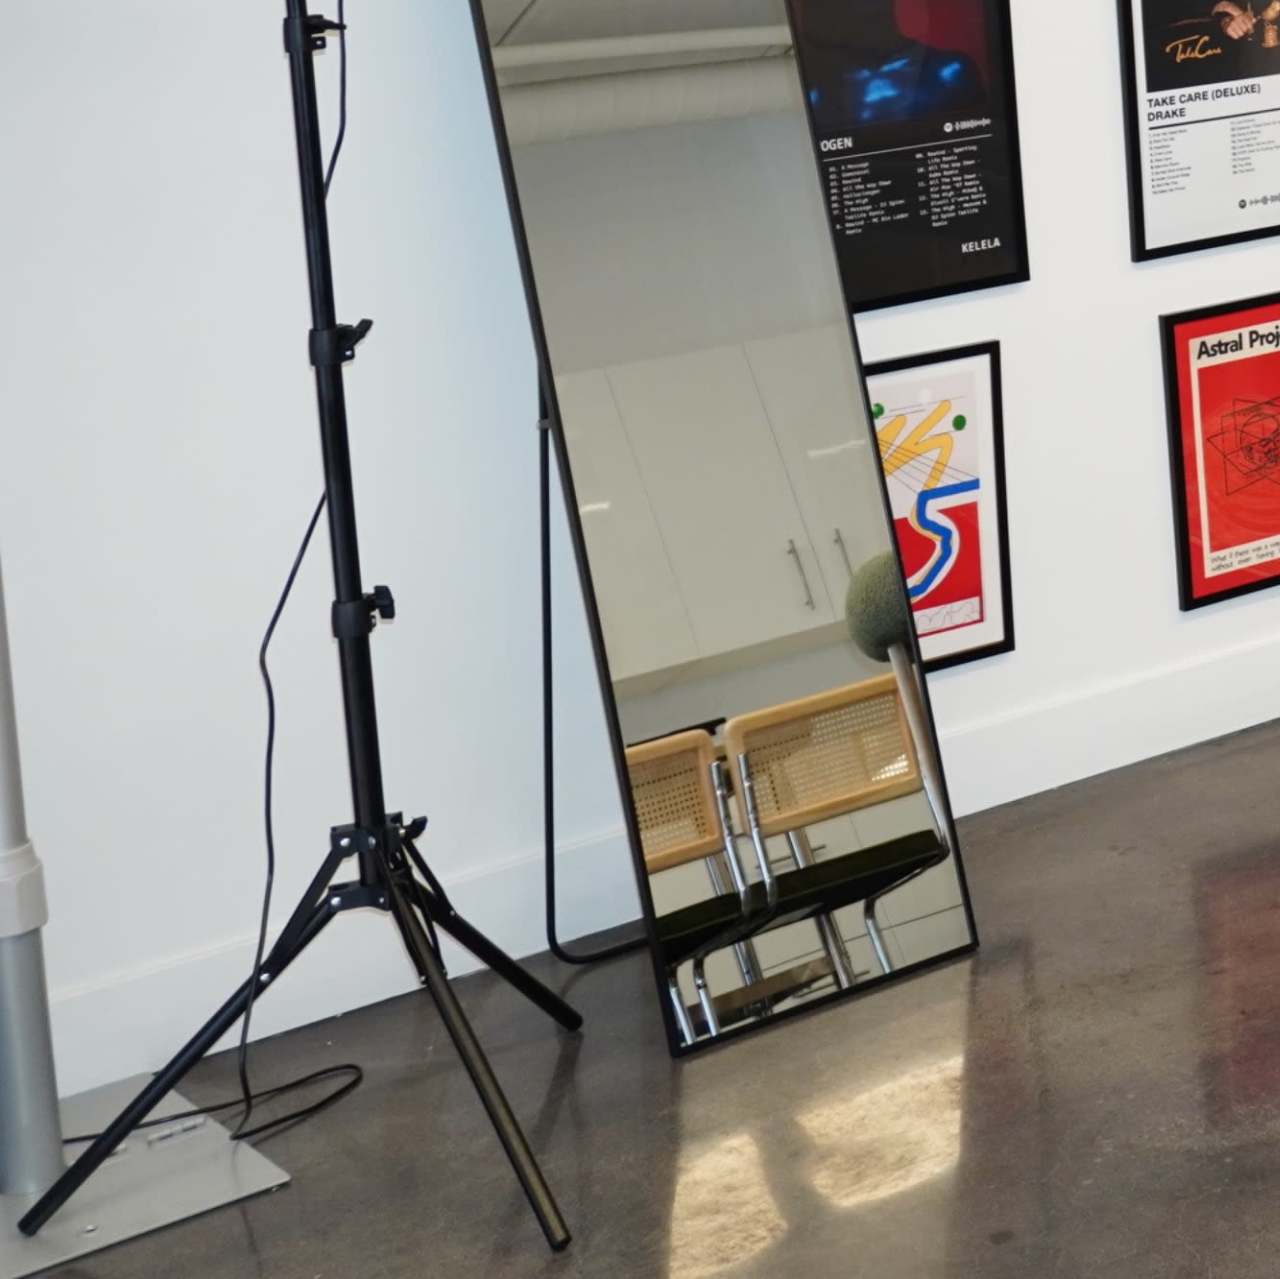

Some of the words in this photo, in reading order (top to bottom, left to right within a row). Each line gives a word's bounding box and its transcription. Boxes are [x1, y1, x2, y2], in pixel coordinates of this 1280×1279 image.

[1146, 95, 1176, 108] TAKE
[1179, 90, 1209, 104] CARE
[1211, 83, 1261, 101] (DELUXE)
[1147, 107, 1187, 122] DRAKE
[961, 237, 1001, 253] KELELA
[1197, 331, 1243, 360] Astral
